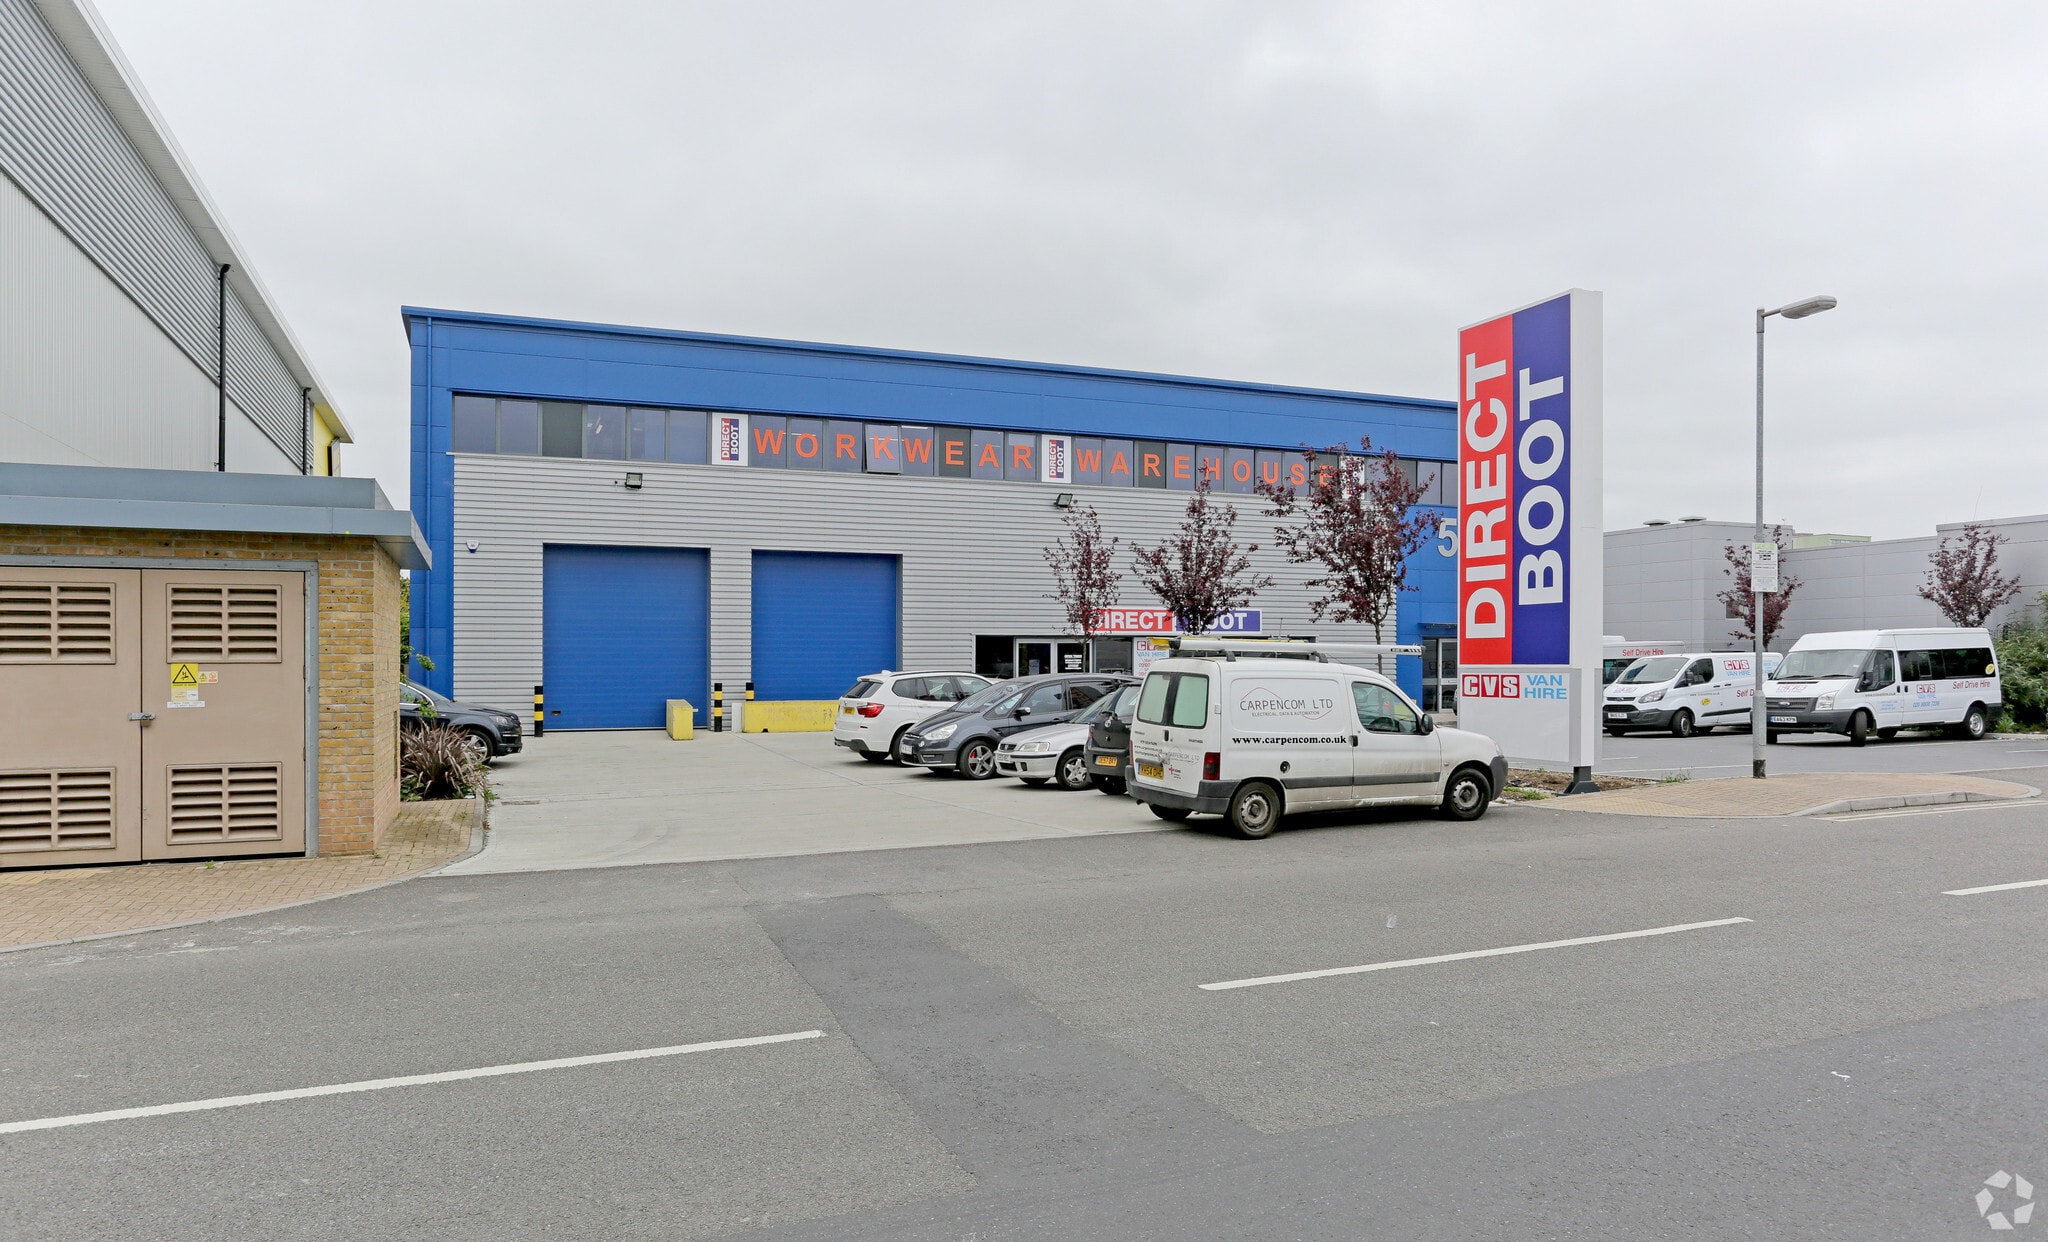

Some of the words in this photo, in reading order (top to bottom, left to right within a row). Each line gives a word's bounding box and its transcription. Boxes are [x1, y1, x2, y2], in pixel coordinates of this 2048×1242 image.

[721, 420, 730, 458] DIRECT
[730, 425, 739, 455] BOOT
[753, 428, 1033, 470] WORKWEAR
[1075, 448, 1334, 488] WAREHOUSE
[1049, 441, 1057, 476] DIRECT
[1518, 367, 1565, 605] BOOT
[1465, 352, 1508, 639] DIRECT
[1437, 518, 1458, 558] 5
[1622, 649, 1634, 657] Self
[1652, 648, 1664, 656] Hire
[1723, 659, 1750, 671] CVS
[1463, 674, 1519, 698] CVS
[1526, 674, 1563, 686] VAN
[1953, 681, 1964, 690] Self
[1965, 680, 1979, 689] Drive
[1980, 680, 1991, 688] Hire
[1524, 687, 1567, 700] HIRE
[1736, 689, 1749, 698] Self
[1916, 683, 1936, 694] CVS
[1240, 699, 1306, 711] CARPENCOM
[1312, 698, 1334, 710] LTD
[1232, 735, 1347, 746] www.carpencom.co.uk
